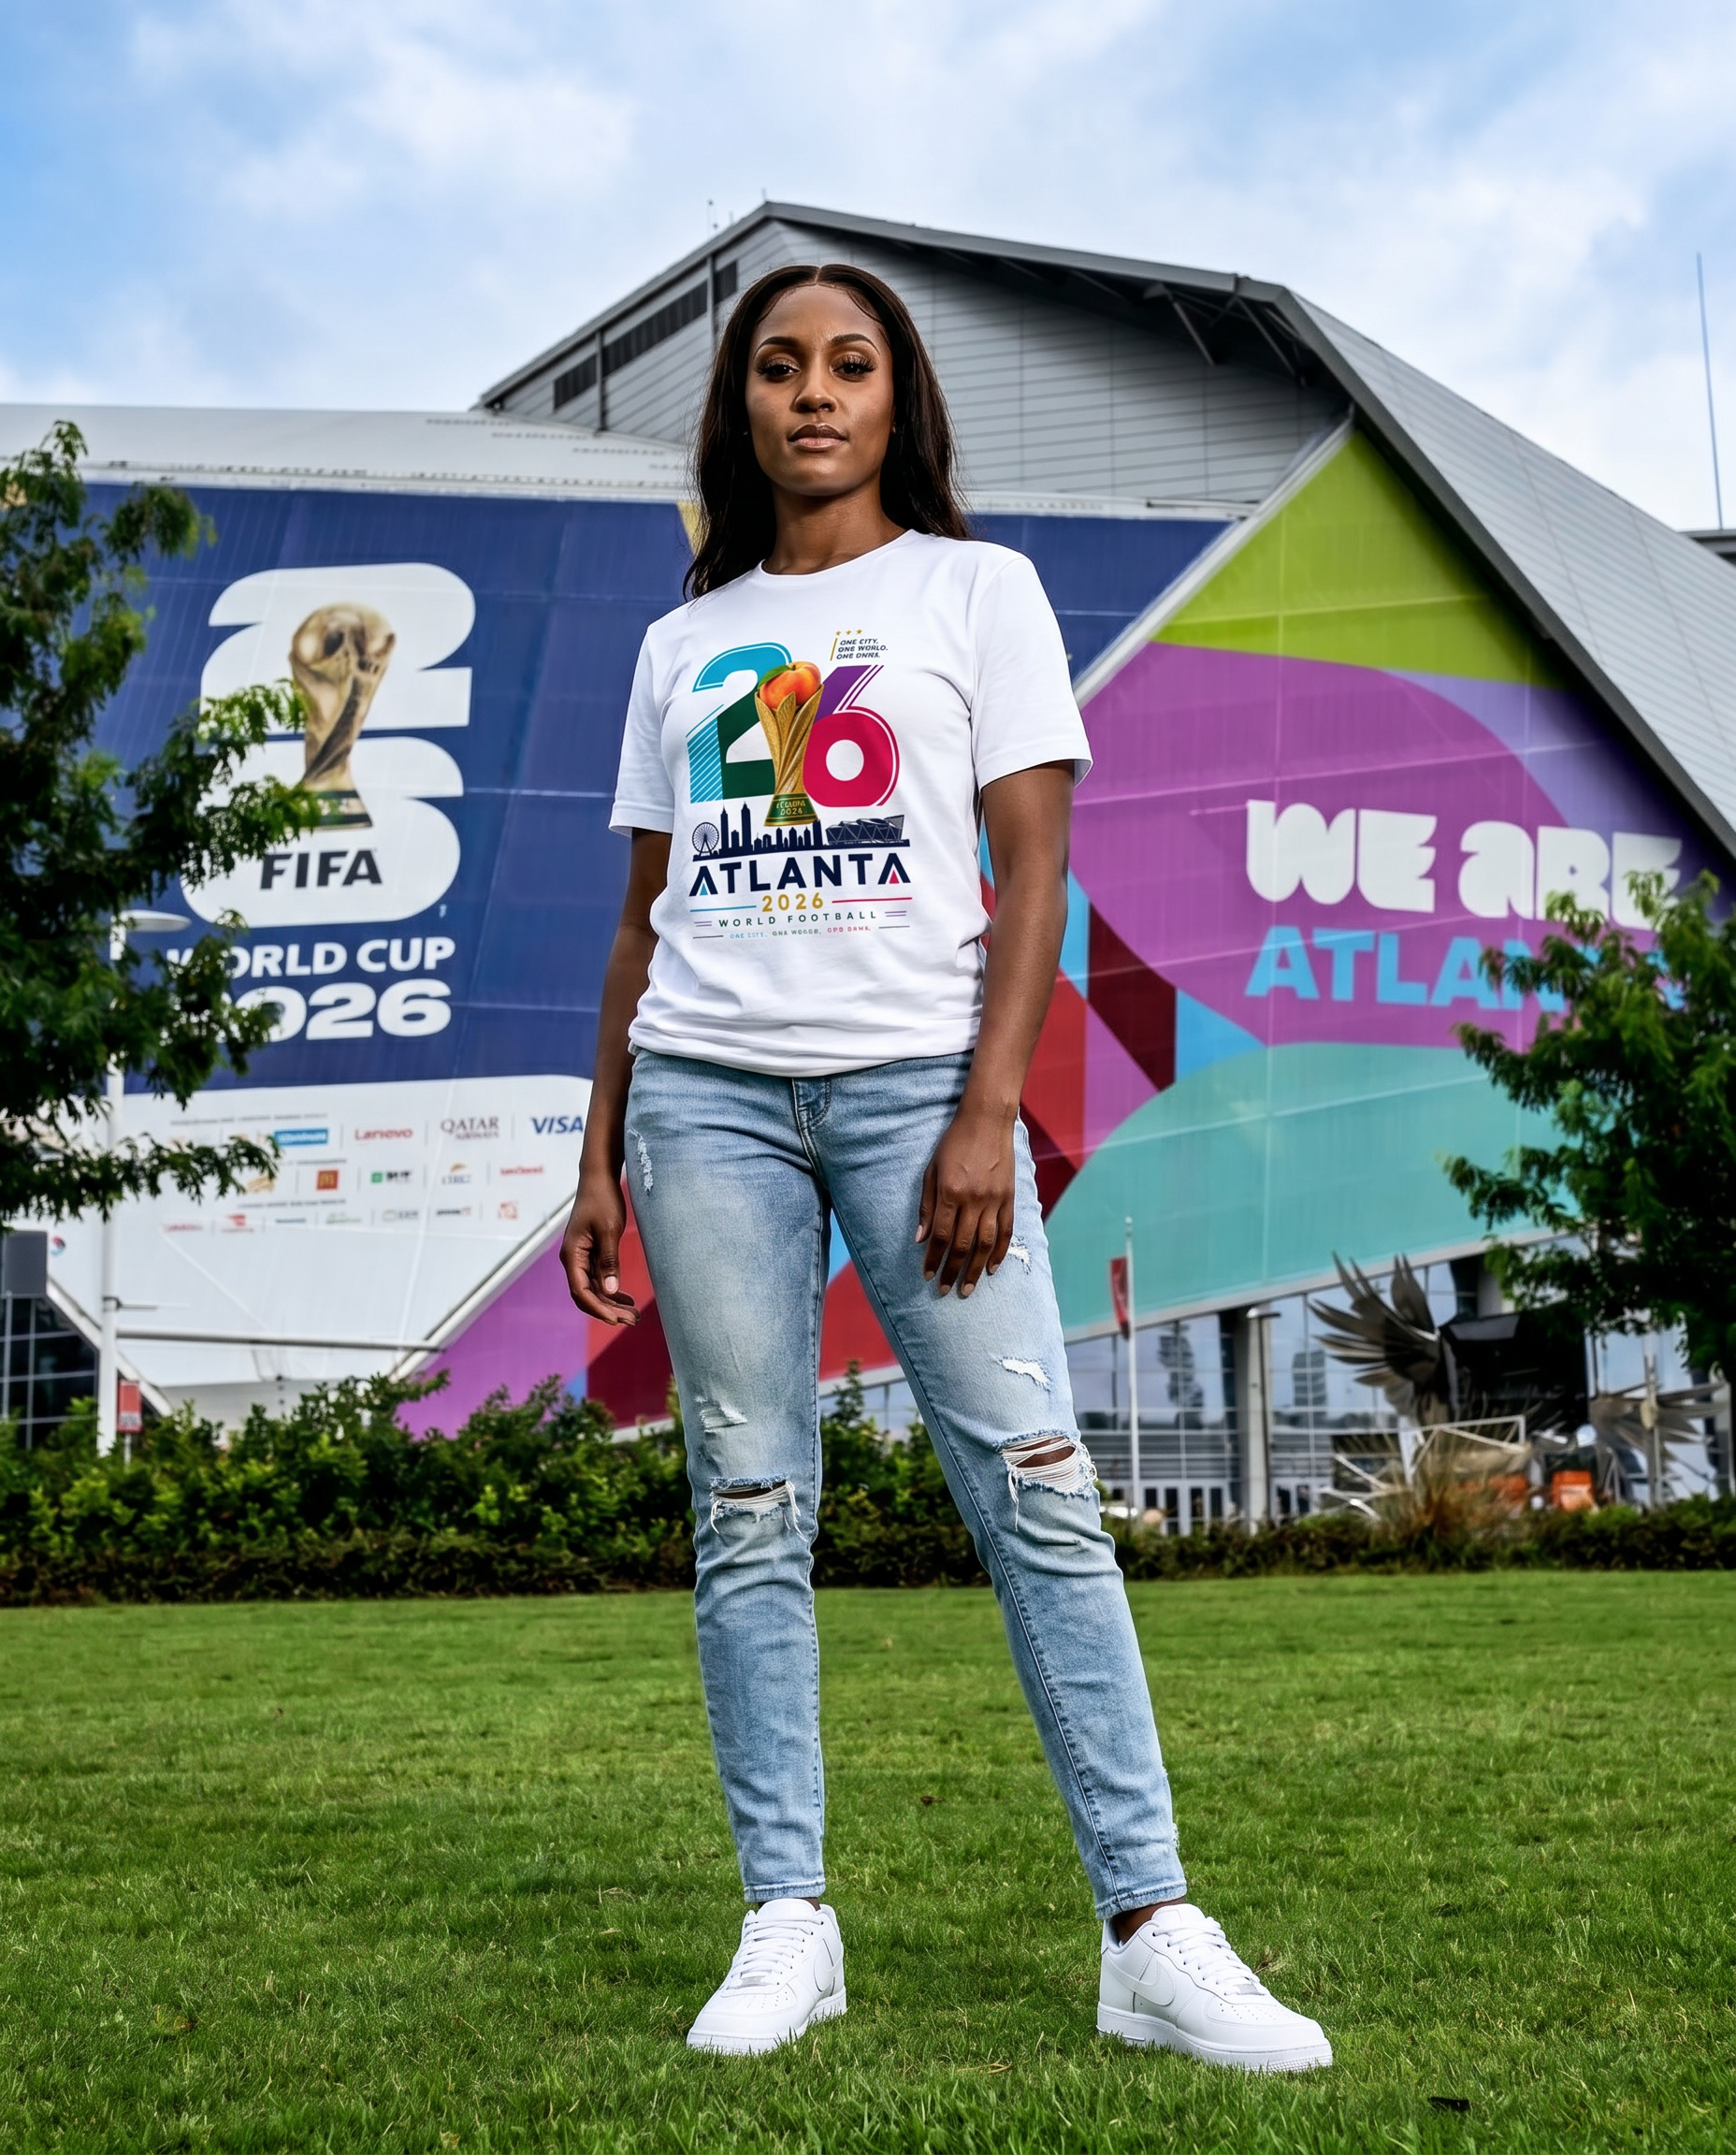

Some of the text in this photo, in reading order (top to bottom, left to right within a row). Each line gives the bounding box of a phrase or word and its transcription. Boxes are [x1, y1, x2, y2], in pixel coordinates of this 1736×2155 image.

[1246, 800, 1438, 913] WE
[260, 849, 382, 889] FIFA
[688, 852, 911, 897] ATLANTA
[761, 892, 824, 913] 2026
[718, 910, 876, 927] WORLD FOOTBALL
[356, 936, 456, 973] CUP
[354, 1125, 413, 1140] Lenovo
[440, 1116, 499, 1134] QATAR
[530, 1115, 584, 1135] VISA
